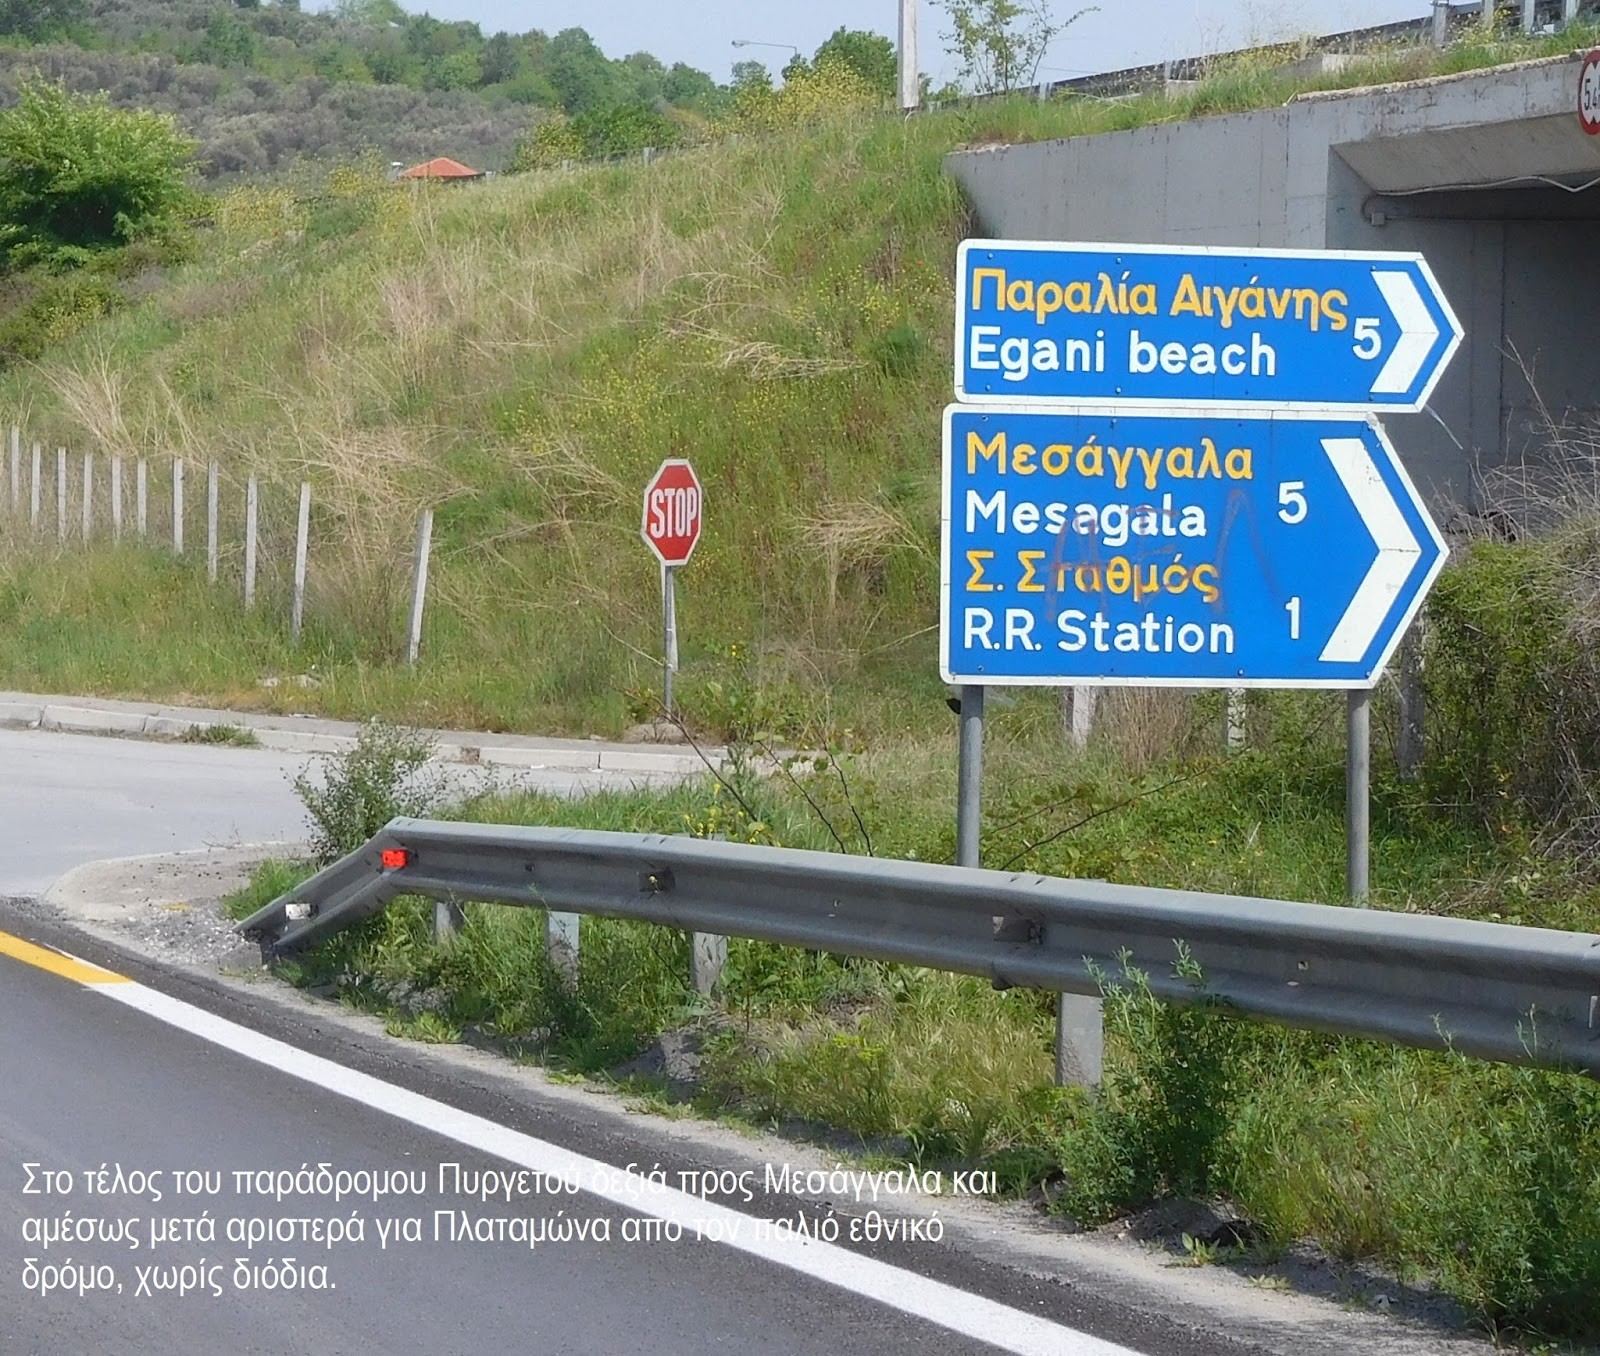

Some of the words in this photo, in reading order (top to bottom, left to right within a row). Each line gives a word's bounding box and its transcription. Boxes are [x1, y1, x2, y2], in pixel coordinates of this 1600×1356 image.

[973, 268, 1157, 324] Παραλία
[1170, 274, 1347, 331] Αιγάνης
[969, 329, 1104, 380] Egani
[1130, 331, 1275, 375] beach
[1353, 318, 1381, 359] 5
[968, 432, 1252, 489] Μεσάγγαλα
[650, 487, 697, 538] STOP
[966, 490, 1206, 546] Mesagala
[1279, 482, 1307, 523] 5
[967, 551, 1003, 591] Σ.
[1017, 552, 1219, 602] Σταθμός
[965, 608, 1041, 650] R.R.
[1058, 610, 1233, 653] Station
[1286, 597, 1299, 638] 1
